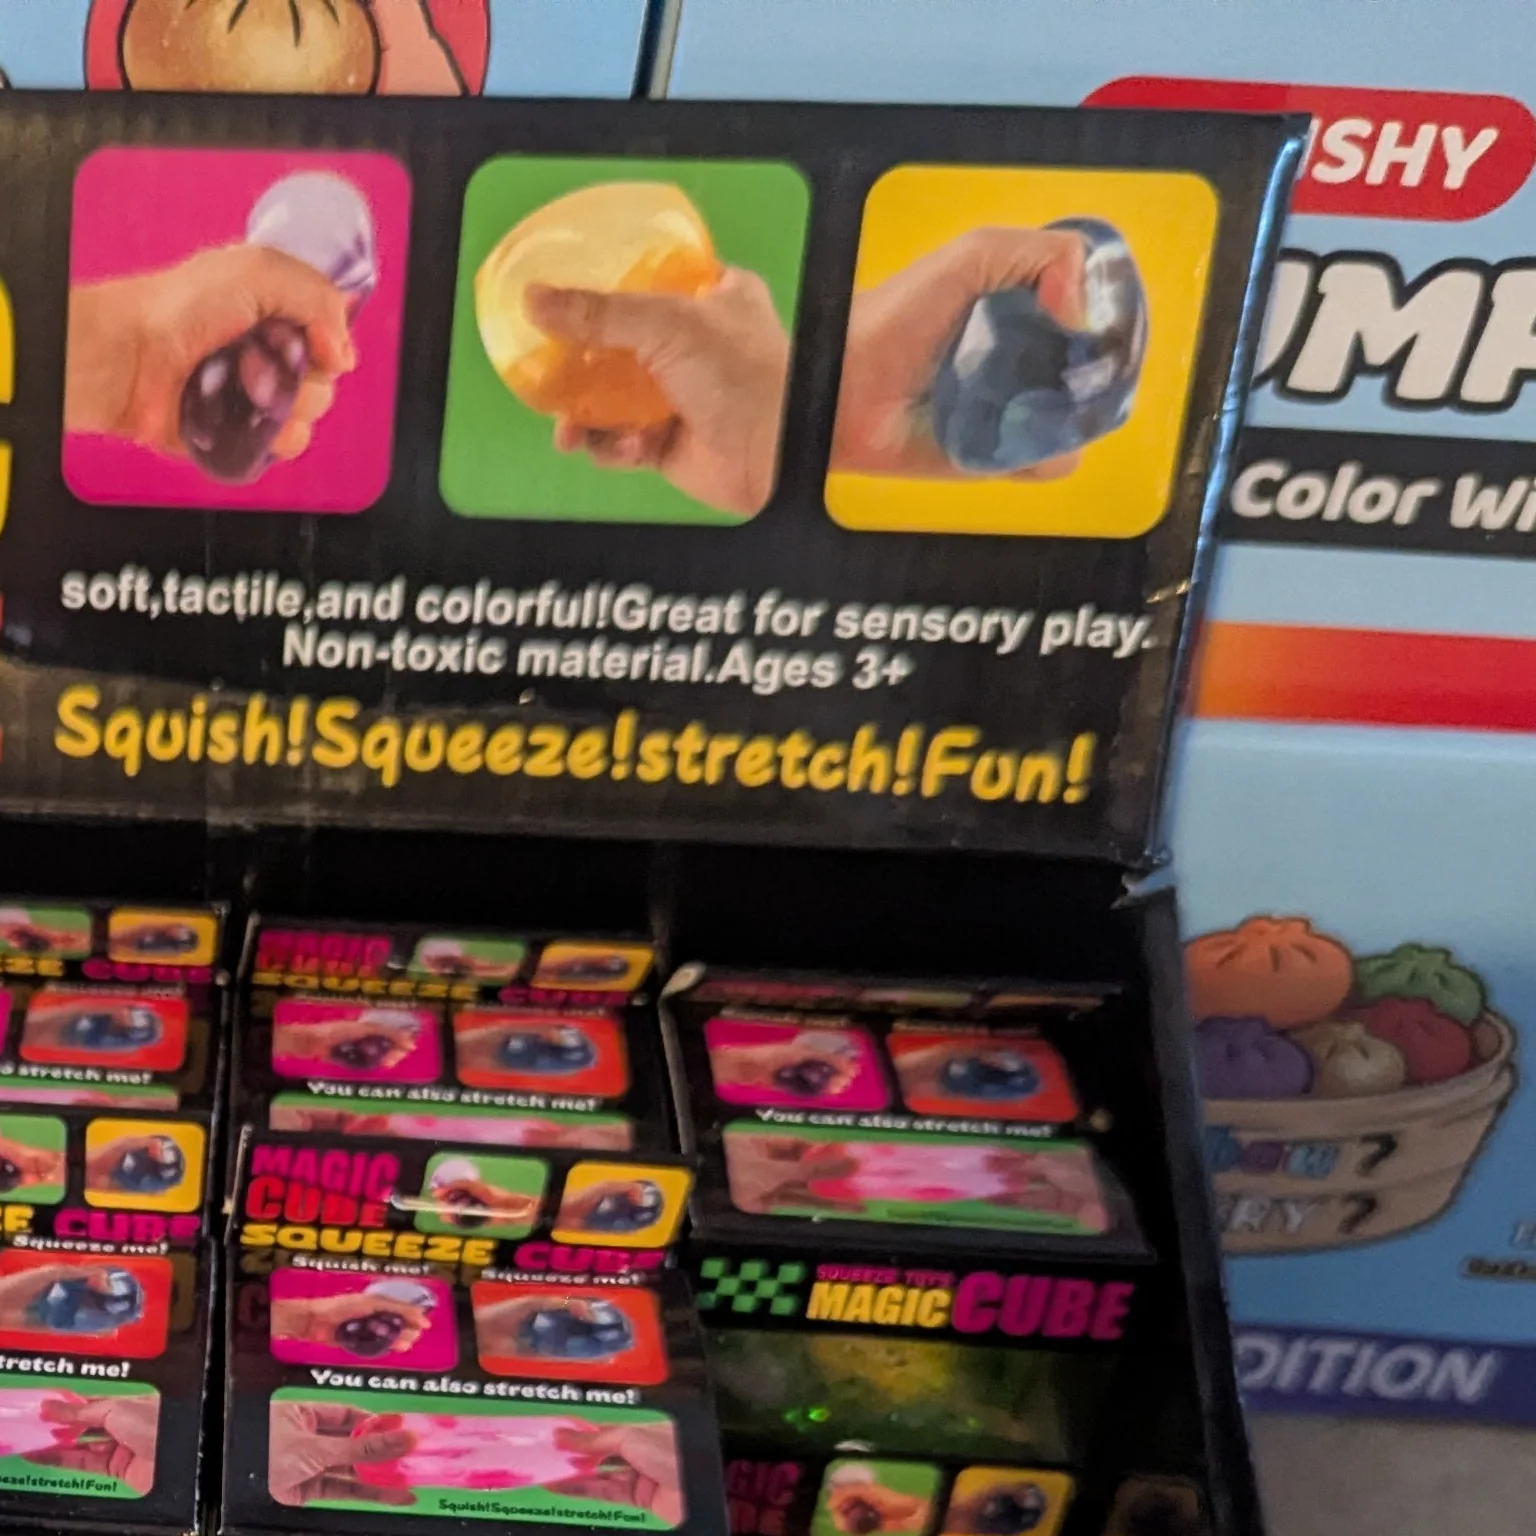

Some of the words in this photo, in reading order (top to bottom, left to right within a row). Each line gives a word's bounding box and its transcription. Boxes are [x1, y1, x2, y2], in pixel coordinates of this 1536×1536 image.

[1304, 116, 1501, 190] SHY
[1230, 459, 1441, 526] Color
[754, 587, 826, 638] for
[833, 600, 1033, 656] sensory
[1039, 603, 1156, 660] play.
[282, 622, 507, 675] Non-toxic
[851, 645, 915, 690] 3+
[246, 1175, 389, 1228] CUBE
[251, 1144, 400, 1203] MAGIC
[53, 1207, 202, 1243] CUBE
[240, 1222, 498, 1267] SQUEEZE
[805, 1281, 952, 1329] MAGIC
[951, 1271, 1136, 1341] CUBE
[80, 1361, 130, 1378] me!
[310, 1367, 363, 1388] You
[368, 1374, 417, 1391] can
[422, 1376, 478, 1395] also
[483, 1379, 580, 1402] stretch
[586, 1387, 637, 1405] me!
[1233, 1334, 1500, 1406] DITION
